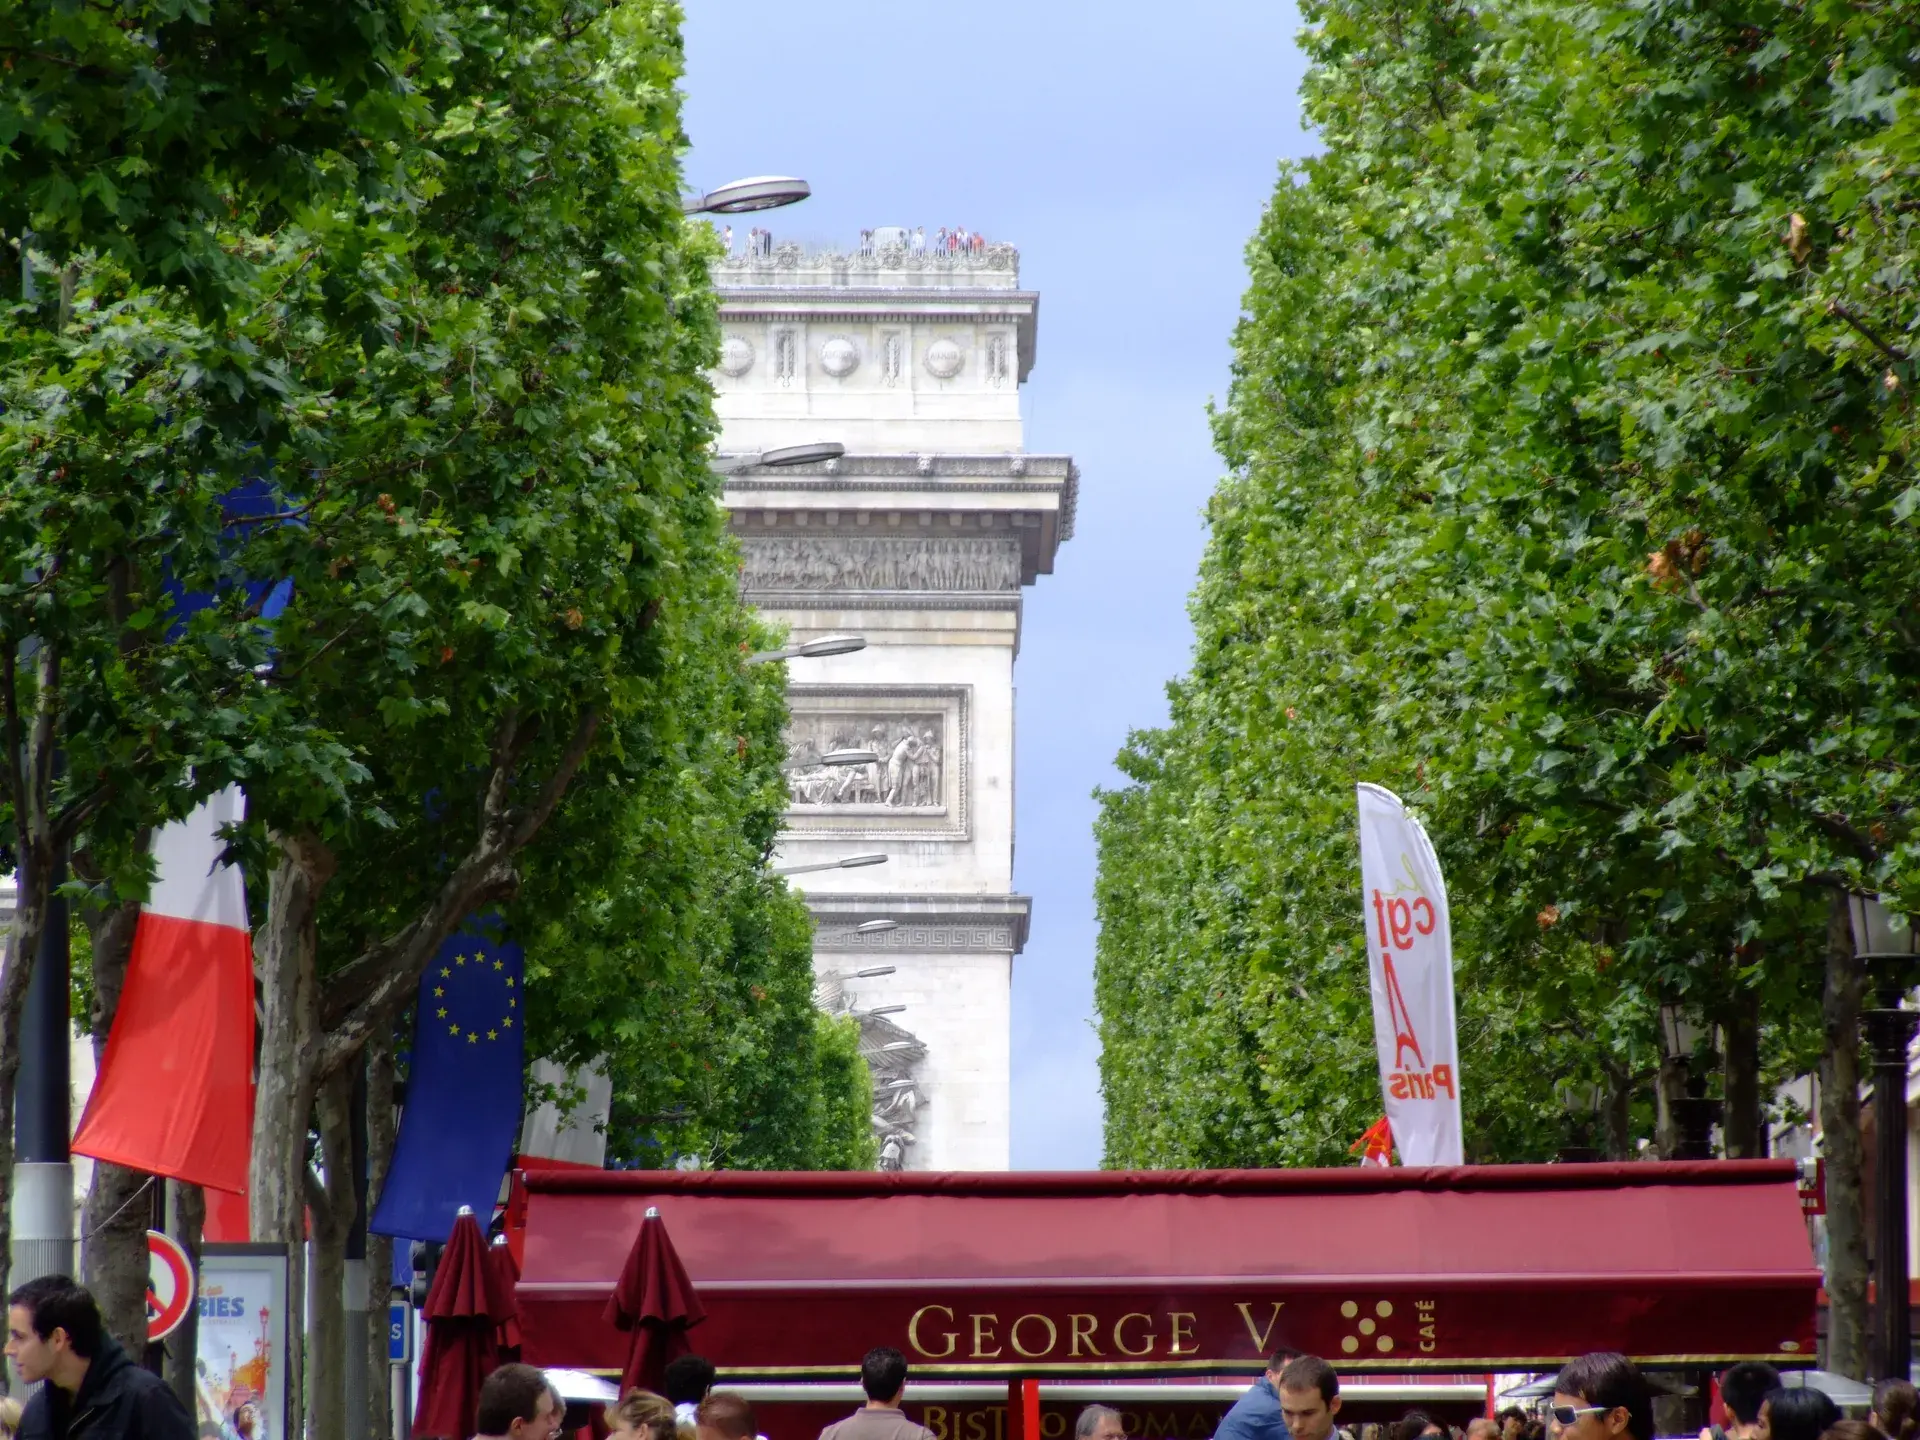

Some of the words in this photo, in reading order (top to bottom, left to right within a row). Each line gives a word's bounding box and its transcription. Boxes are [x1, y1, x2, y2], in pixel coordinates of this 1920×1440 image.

[908, 1304, 1200, 1358] GEORGE
[1234, 1302, 1285, 1353] V
[1414, 1300, 1435, 1352] CAFÉ
[923, 1405, 1067, 1440] BISTO
